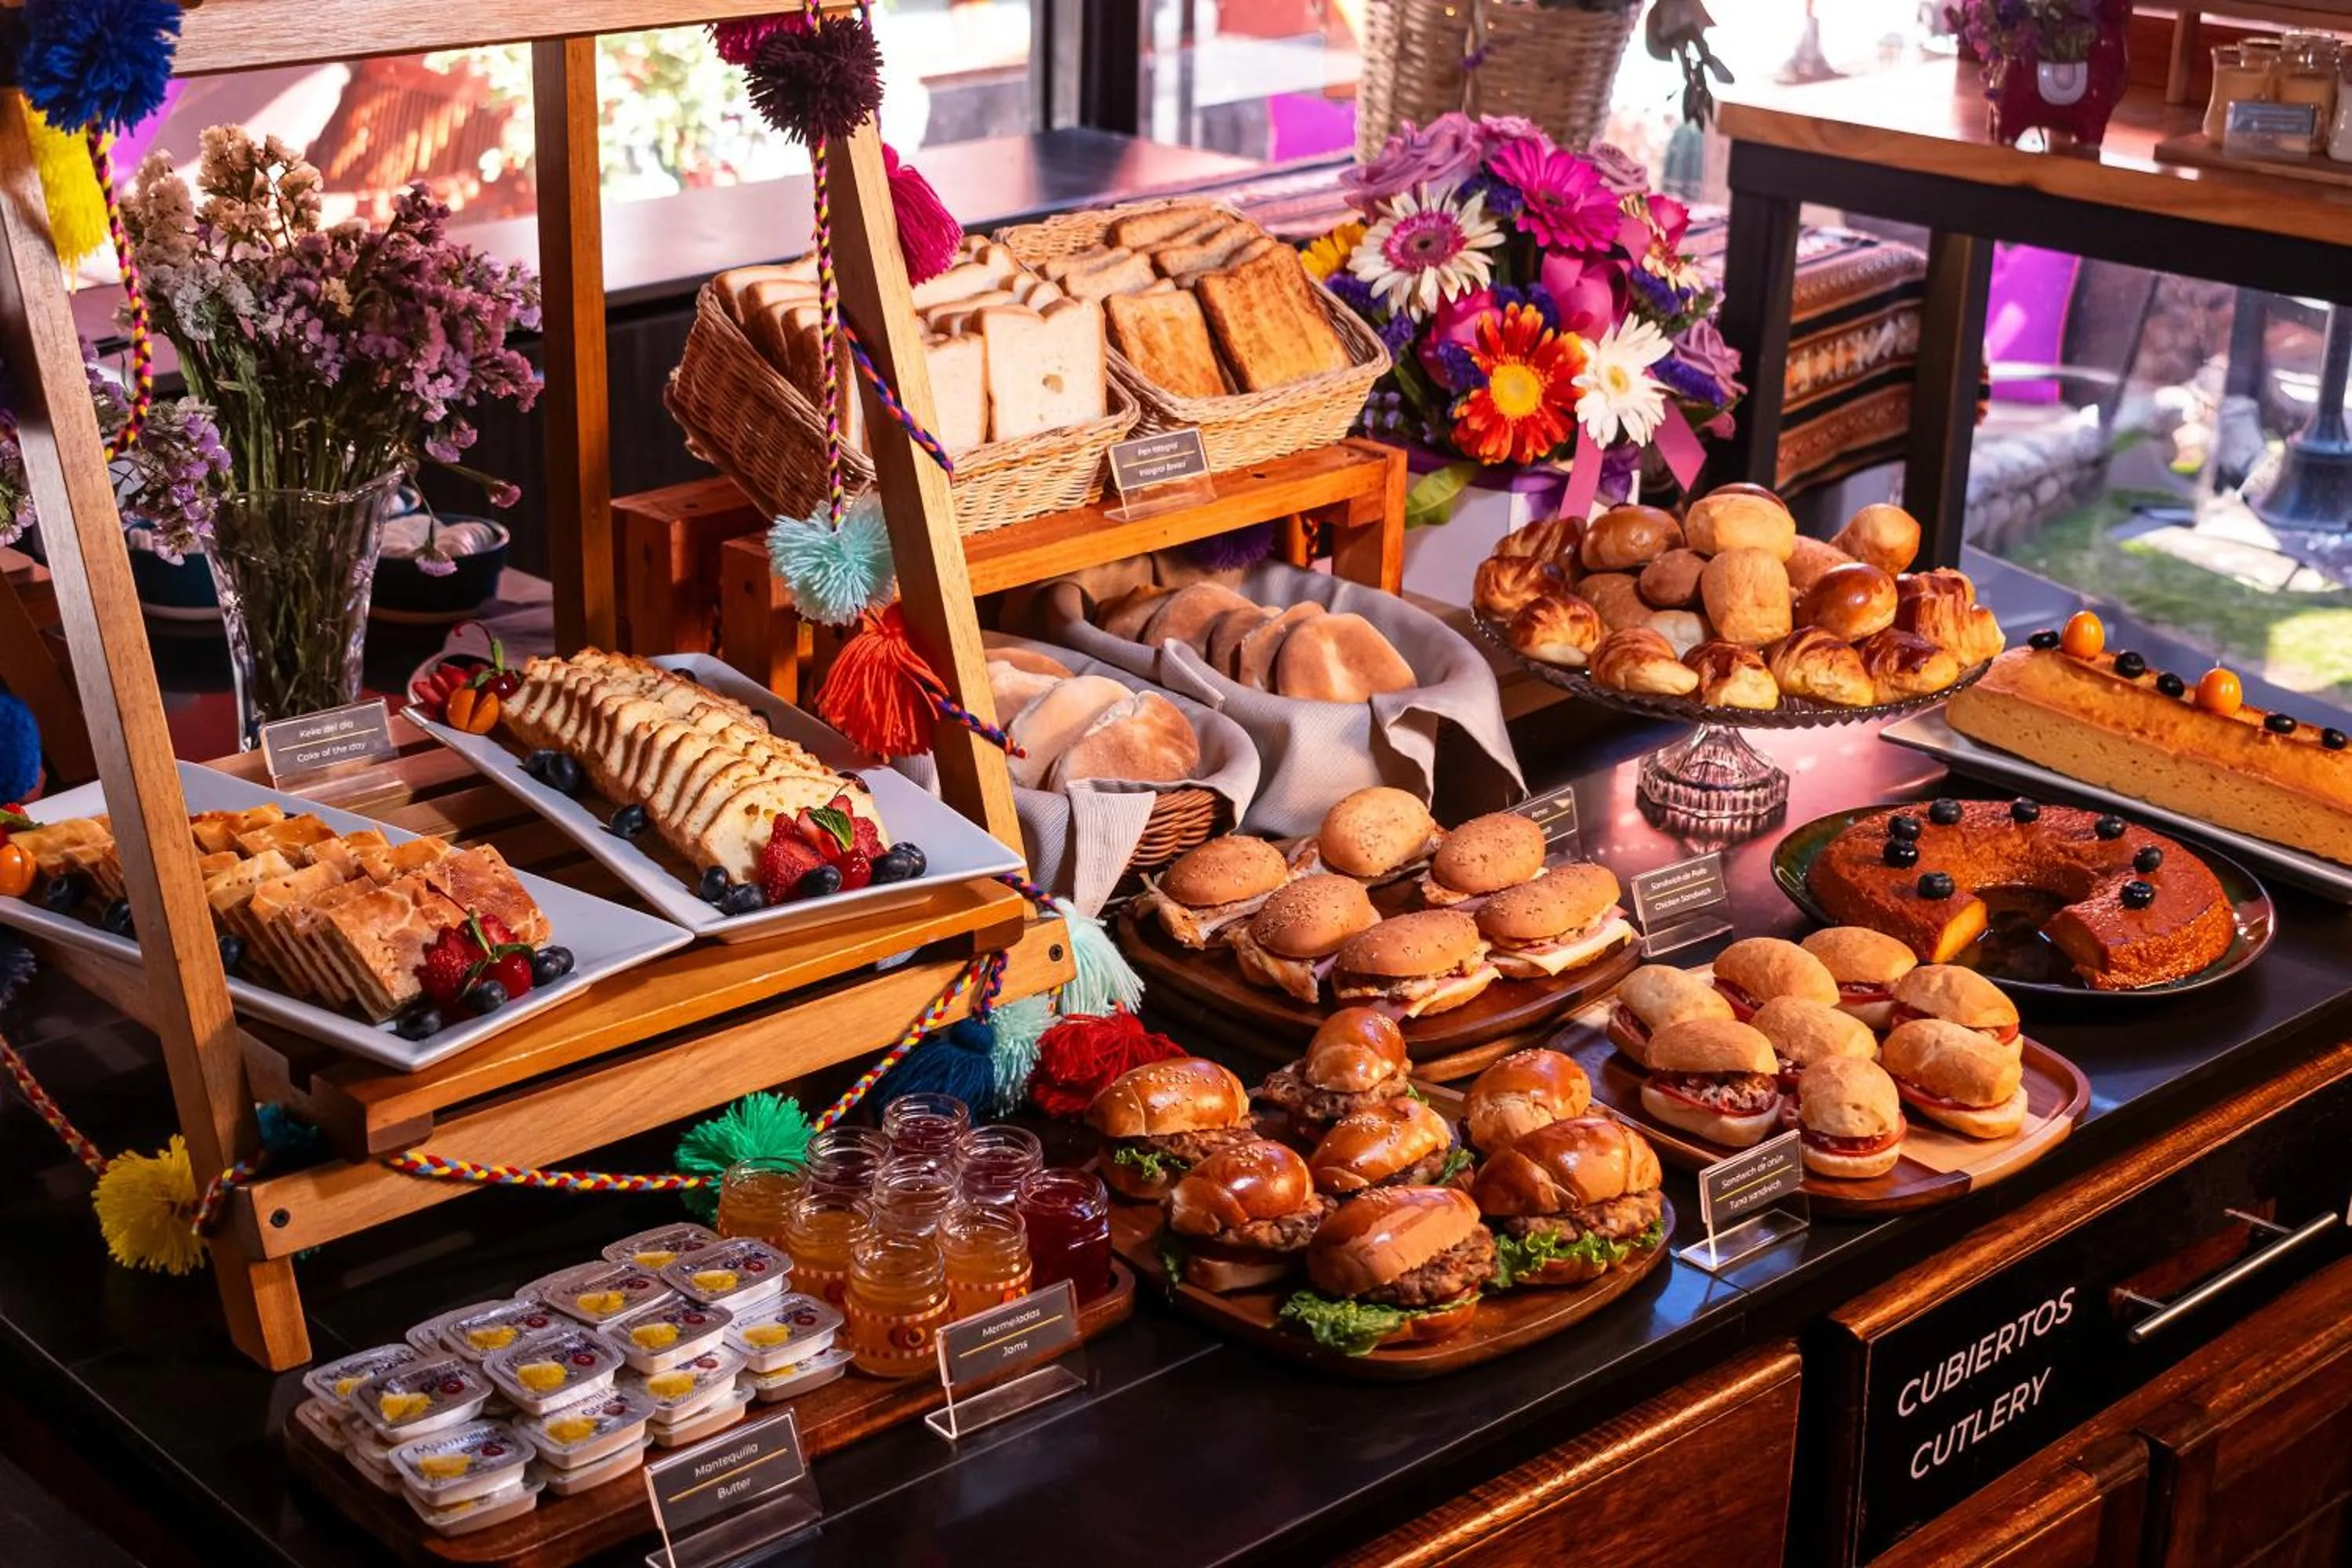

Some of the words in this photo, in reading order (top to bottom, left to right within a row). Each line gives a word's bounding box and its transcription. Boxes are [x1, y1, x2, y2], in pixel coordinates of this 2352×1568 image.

[321, 747, 331, 757] of
[332, 744, 347, 755] the
[349, 741, 366, 752] day
[1722, 1167, 1756, 1189] Sandwich
[1757, 1163, 1766, 1173] de
[1729, 1196, 1748, 1210] Tuna
[1748, 1179, 1782, 1200] sandwich
[983, 1309, 1040, 1337] Mermeladas
[1003, 1341, 1028, 1357] Jams
[1897, 1286, 2076, 1417] CUBIERTOS
[1910, 1367, 2052, 1480] CUTLERY
[695, 1443, 758, 1477] Mantequilla
[717, 1478, 751, 1499] Butter
